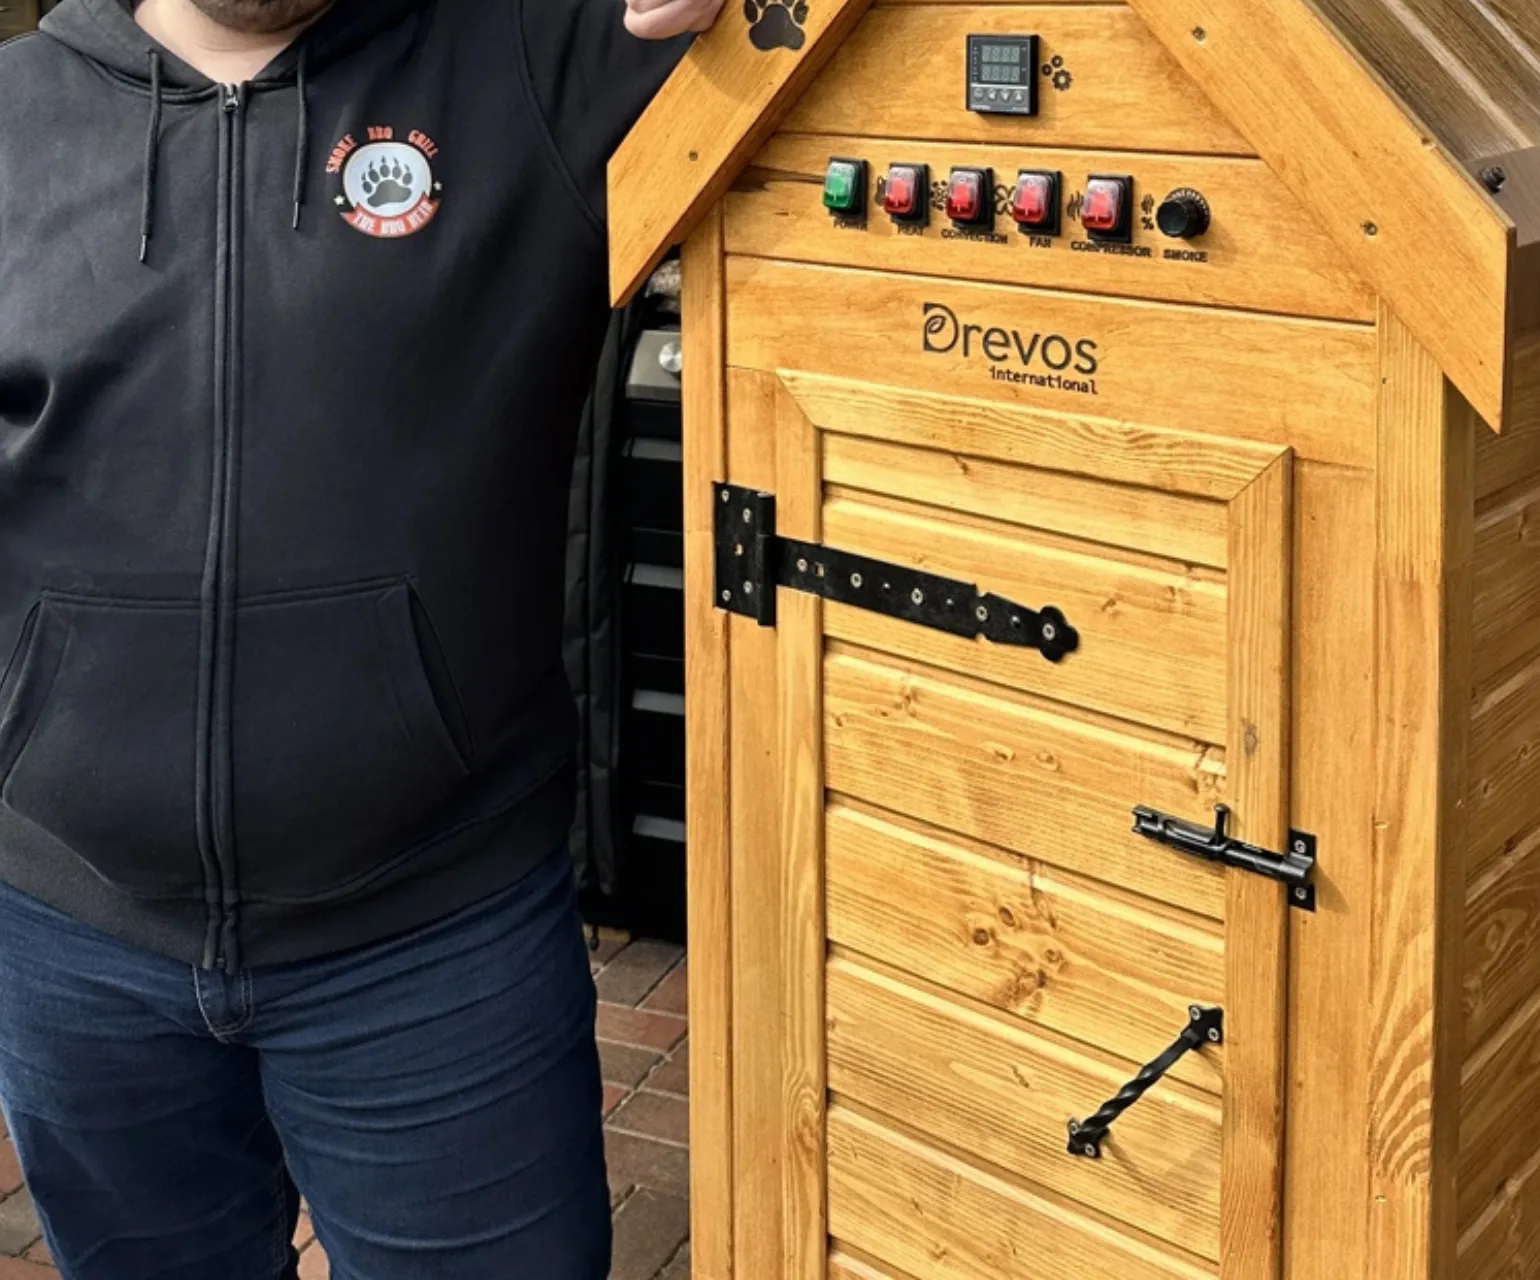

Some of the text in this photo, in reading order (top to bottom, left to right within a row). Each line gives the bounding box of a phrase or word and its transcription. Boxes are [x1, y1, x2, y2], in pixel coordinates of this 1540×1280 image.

[1163, 248, 1208, 263] SMOKE
[922, 301, 1099, 375] Drevos
[989, 365, 1099, 395] international
